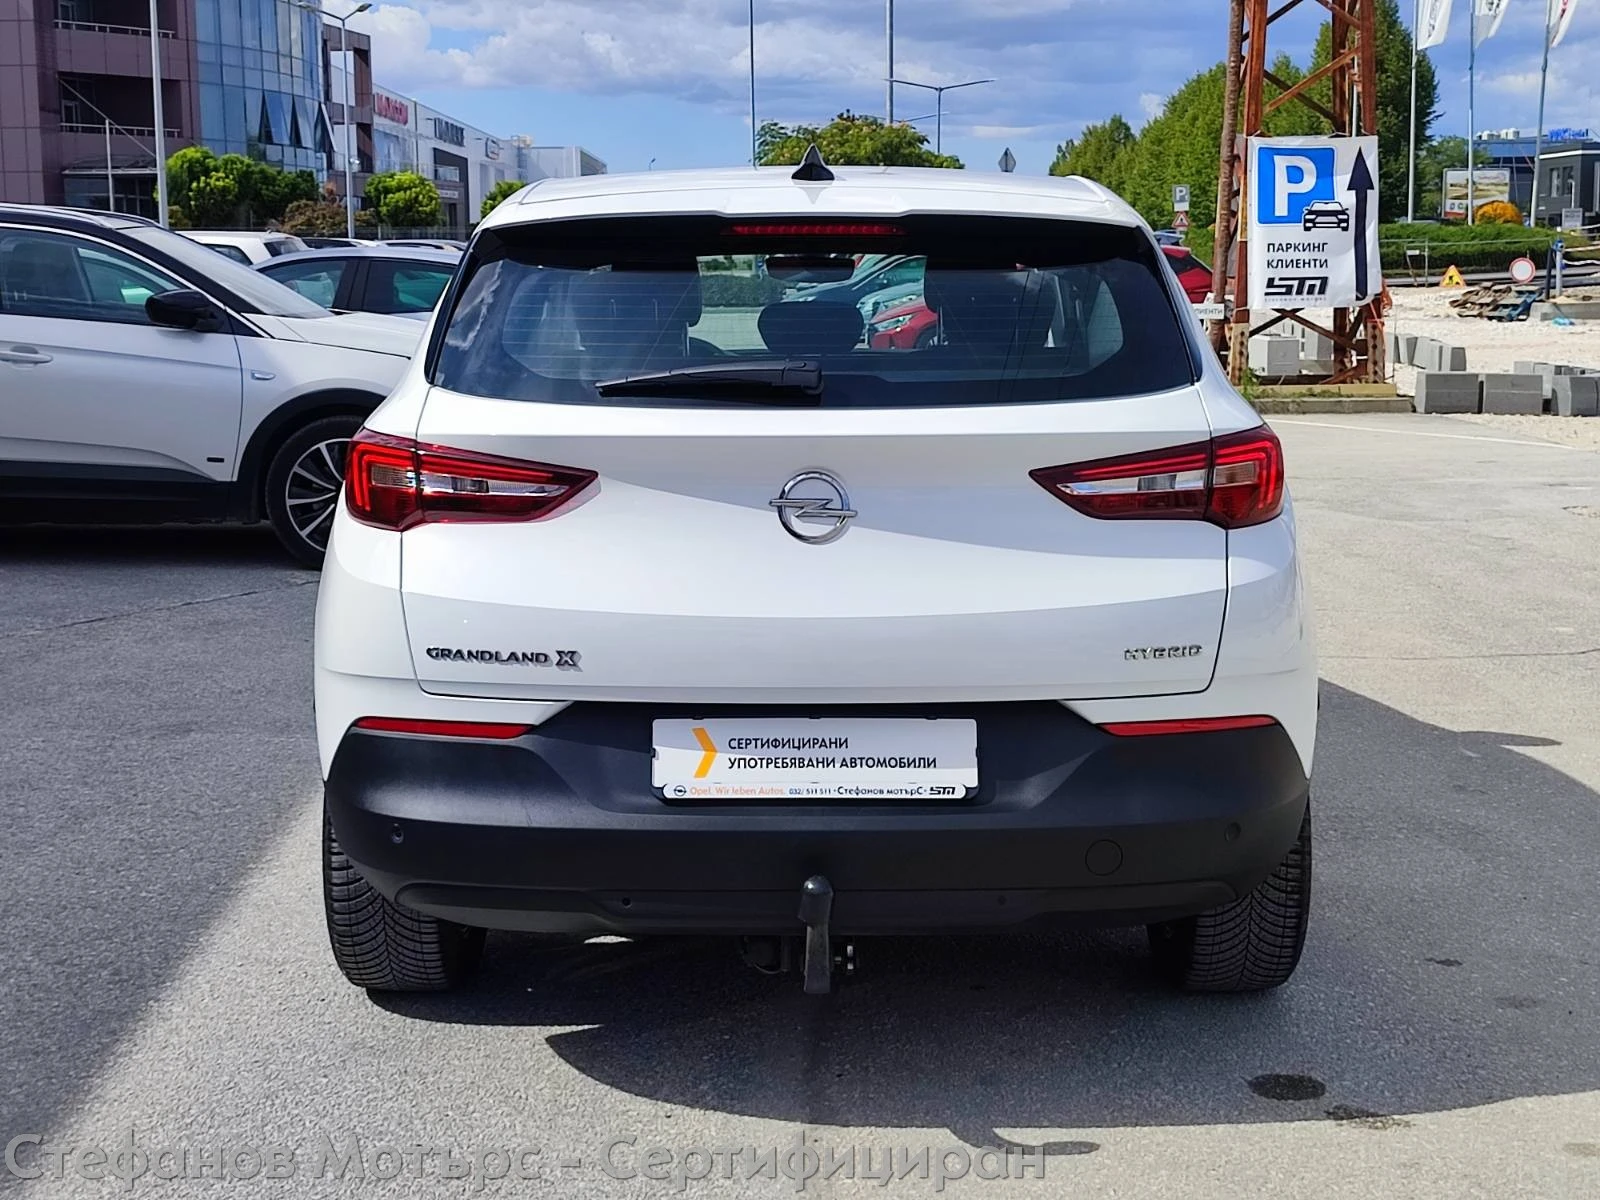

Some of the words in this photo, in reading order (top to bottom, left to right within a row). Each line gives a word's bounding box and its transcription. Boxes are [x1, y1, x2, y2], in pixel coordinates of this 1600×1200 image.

[1273, 155, 1317, 216] P
[1176, 187, 1186, 200] P
[1267, 242, 1328, 253] ПАРКИНГ
[1267, 258, 1328, 269] КЛИЕНТИ
[426, 647, 550, 664] GRANDLAND
[555, 650, 578, 668] X
[1124, 645, 1202, 660] HYBRID
[728, 737, 848, 751] СЕРТИФИЦИРАНИ
[728, 757, 835, 769] УПОТРЕБЯВАНИ
[840, 756, 937, 769] АВТОМОБИЛИ
[837, 786, 884, 796] Стефанов
